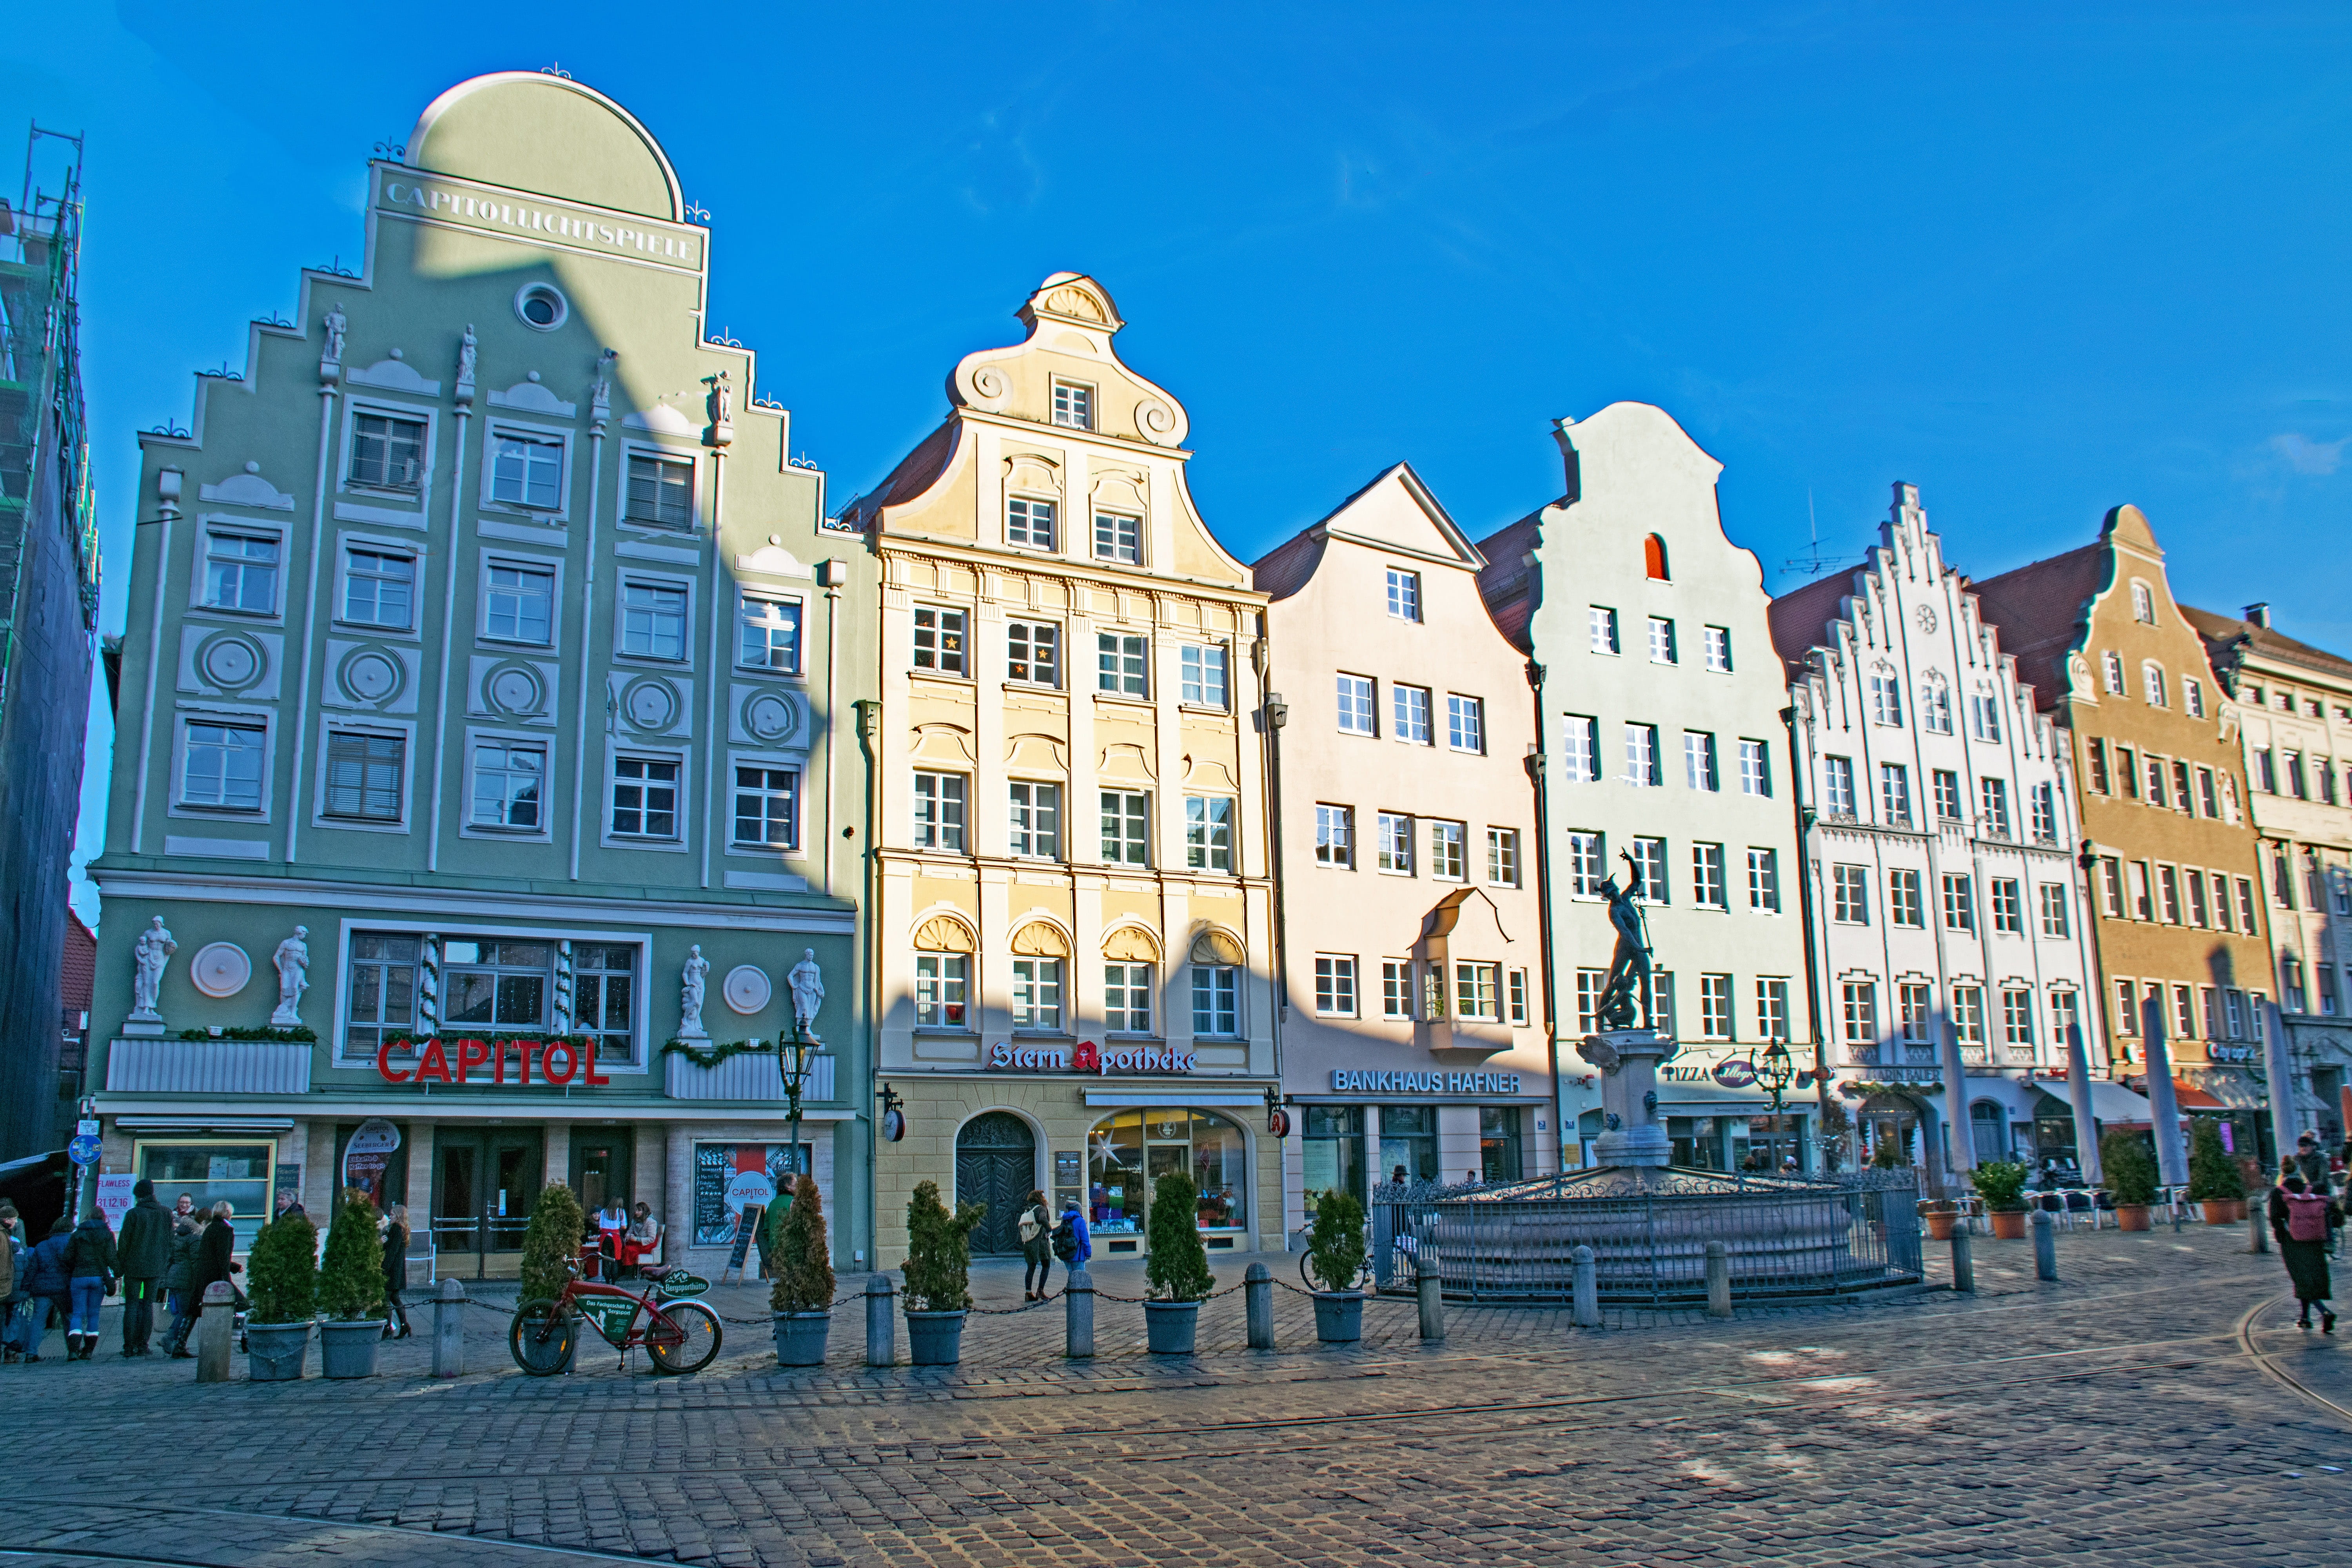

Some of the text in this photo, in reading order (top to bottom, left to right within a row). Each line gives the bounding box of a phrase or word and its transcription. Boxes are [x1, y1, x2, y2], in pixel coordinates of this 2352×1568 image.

[377, 1038, 610, 1085] CAPITOL
[988, 1040, 1198, 1076] Stern Apotheke
[1666, 1067, 1711, 1081] PIZZA
[1719, 1064, 1759, 1082] Allegr
[1906, 1069, 1940, 1081] BAUER
[1334, 1069, 1521, 1093] BANKHAUS HAFNER
[98, 1198, 127, 1207] 31.12.16
[666, 1283, 706, 1292] Bergsporthütte
[597, 1301, 626, 1309] Fachgeschäft
